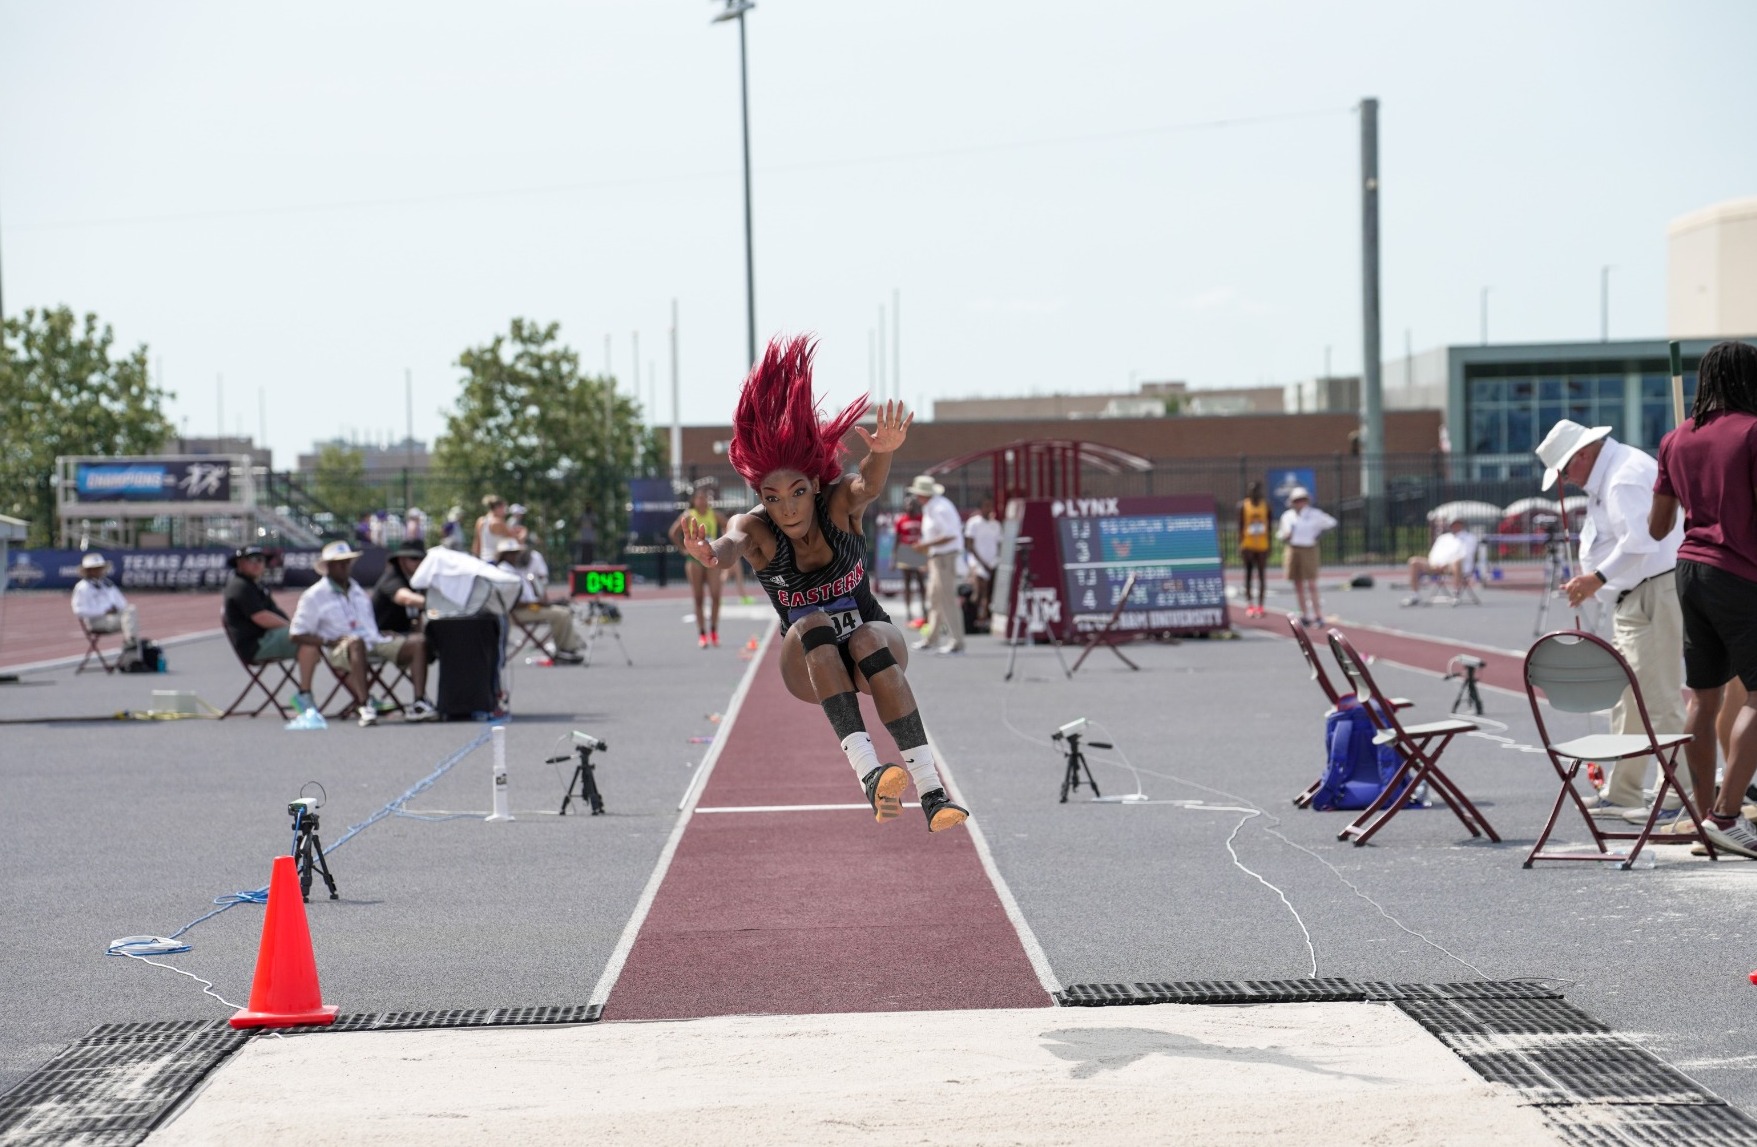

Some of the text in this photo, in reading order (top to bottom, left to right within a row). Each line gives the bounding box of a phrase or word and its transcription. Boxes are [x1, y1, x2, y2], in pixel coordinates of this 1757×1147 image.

[1066, 498, 1120, 518] LYNX
[121, 554, 181, 569] TEXAS
[121, 569, 200, 587] COLLEGE
[778, 558, 864, 607] EASTERN
[1150, 608, 1223, 628] UNIVERSITY
